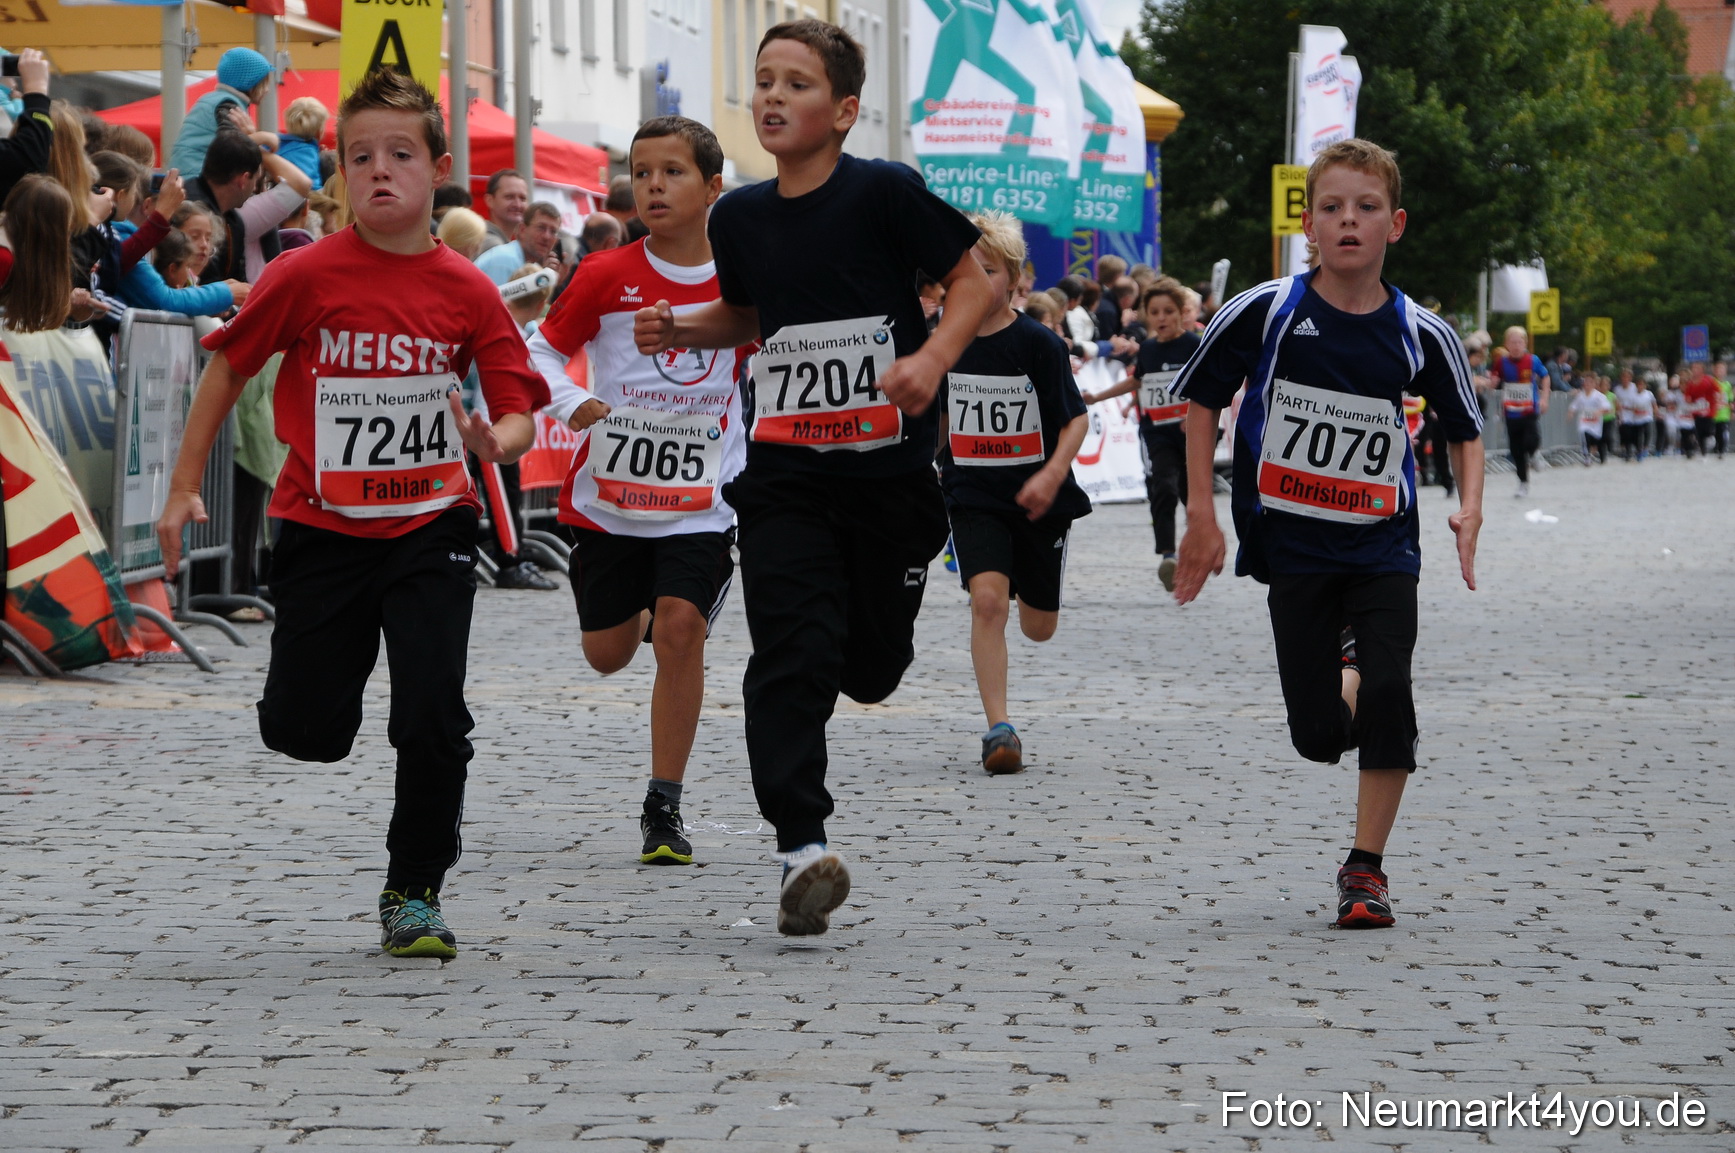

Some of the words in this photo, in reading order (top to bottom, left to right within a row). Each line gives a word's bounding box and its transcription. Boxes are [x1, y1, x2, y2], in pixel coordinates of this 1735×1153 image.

[365, 18, 414, 78] A
[924, 98, 1051, 118] Gebäudereinigung
[925, 115, 1004, 127] Mietservice
[924, 130, 1053, 147] Hausmeisterdienst
[924, 161, 1060, 189] Service-Line:
[1280, 168, 1307, 180] Bloc
[993, 188, 1048, 213] 6352
[1286, 187, 1306, 218] B
[620, 295, 643, 303] erima
[1537, 302, 1551, 322] C
[1293, 328, 1320, 337] adidas
[1595, 329, 1606, 346] D
[318, 328, 461, 373] MEISTE
[754, 339, 797, 357] ARTL
[799, 334, 868, 352] Neumarkt
[768, 355, 883, 412] 7204
[975, 385, 1021, 395] Neumarkt
[319, 392, 372, 406] PARTL
[376, 389, 441, 406] Neumarkt
[622, 384, 667, 402] LAUFEN
[672, 395, 696, 406] MIT
[699, 394, 726, 405] HERZ
[955, 399, 1028, 434] 7167
[1275, 392, 1321, 414] PARTL
[1324, 404, 1389, 426] Neumarkt
[598, 416, 639, 431] ARTL
[642, 422, 702, 438] Neumarkt
[791, 415, 862, 440] Marcel
[335, 410, 448, 467] 7244
[971, 440, 1012, 455] Jakob
[1281, 414, 1391, 477] 7079
[605, 432, 706, 482] 7065
[362, 478, 430, 500] Fabian
[616, 487, 680, 507] Joshua
[1279, 474, 1371, 511] Christoph
[457, 554, 471, 562] JAKO
